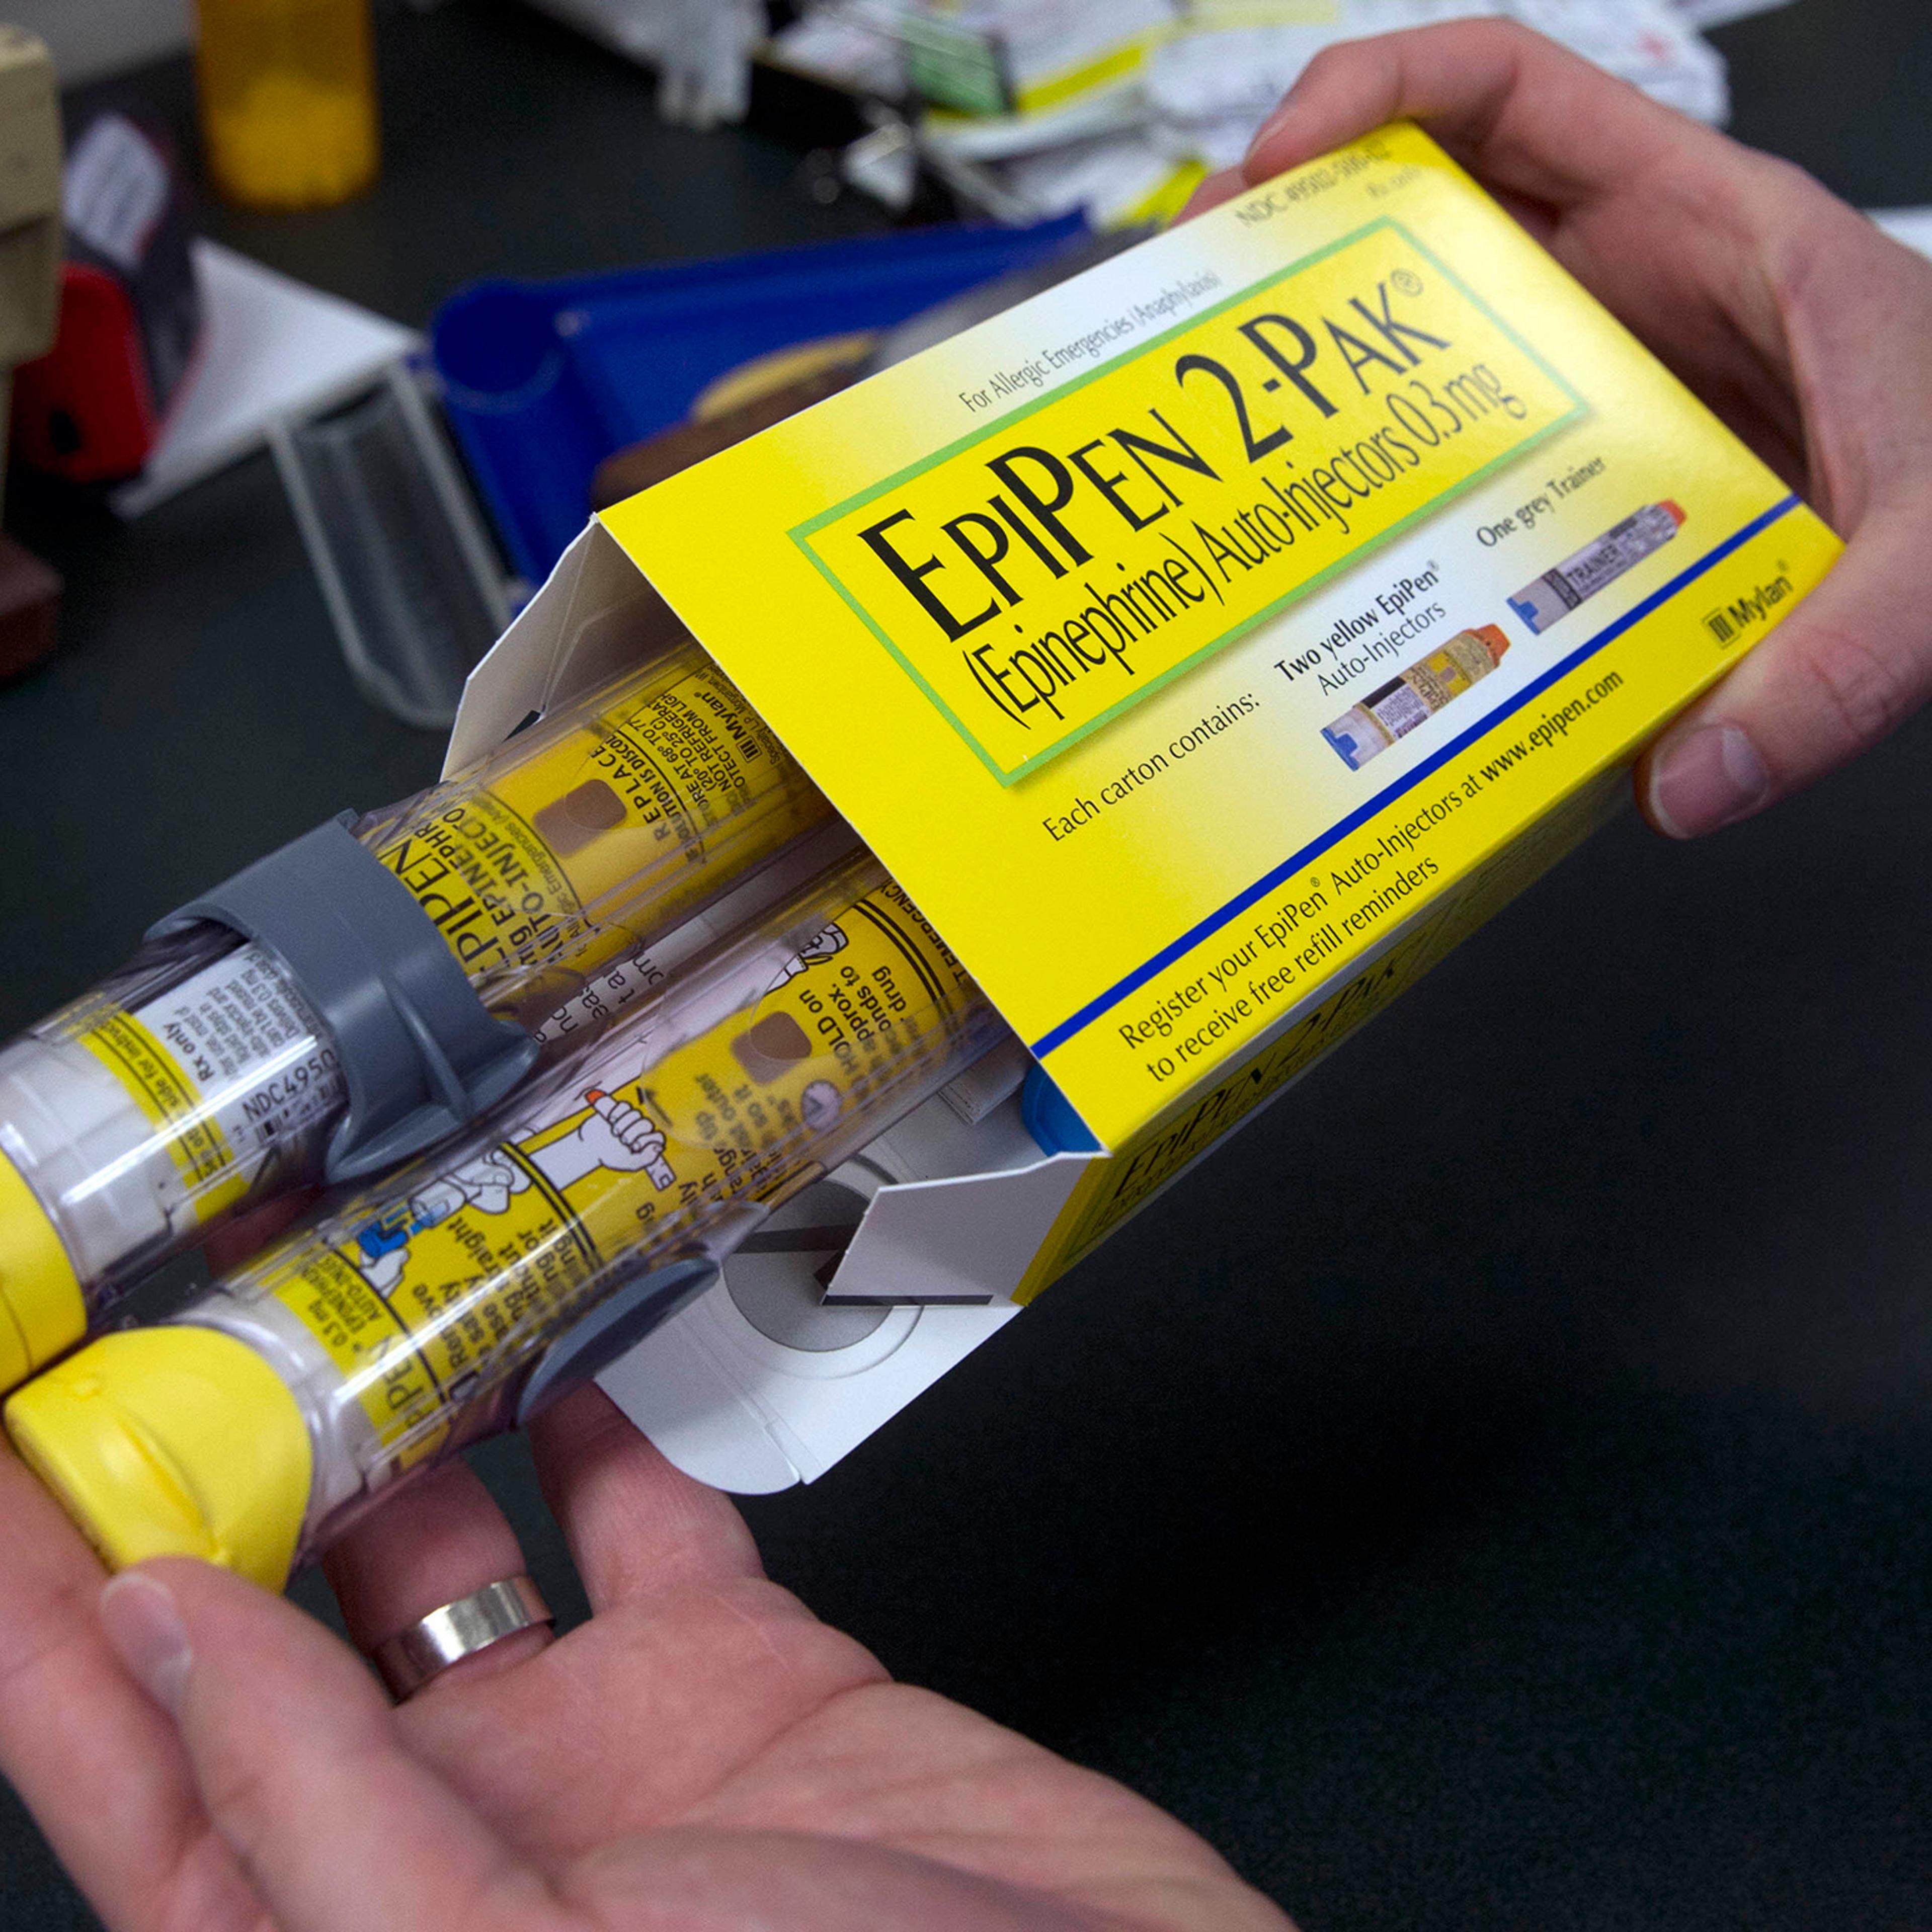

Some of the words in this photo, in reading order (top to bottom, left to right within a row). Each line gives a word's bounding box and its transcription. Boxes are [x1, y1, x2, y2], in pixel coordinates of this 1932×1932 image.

[958, 388, 992, 413] For
[989, 359, 1051, 400] Allergic
[1041, 315, 1135, 371] Emergencies
[1476, 517, 1517, 547] One
[1515, 496, 1552, 529] grey
[1546, 456, 1605, 499] Trainer
[961, 530, 1226, 733] (Epinephrine)
[1190, 423, 1422, 586] Auto-Injectors
[1442, 361, 1527, 425] mg
[1273, 648, 1321, 682] Two
[1319, 608, 1380, 661] yellow
[1317, 601, 1446, 697] Auto-Injectors
[642, 725, 662, 746] TO
[651, 714, 667, 731] C)
[683, 709, 718, 744] FROM
[640, 768, 656, 783] IS
[673, 764, 693, 780] AT
[679, 747, 698, 767] TO
[1042, 797, 1100, 842] Each
[1100, 754, 1169, 805] carton
[1168, 692, 1260, 759] contains:
[590, 745, 670, 840] REPLACE
[707, 763, 732, 792] NOT
[648, 780, 694, 844] OLUTION
[1118, 977, 1210, 1051] Register
[1207, 940, 1259, 992] your
[1329, 790, 1464, 897] Auto-Injectors
[1460, 774, 1483, 798] at
[1479, 671, 1624, 783] www.epipen.com
[840, 965, 860, 987] to
[871, 965, 907, 1012] drug
[1146, 1057, 1175, 1082] to
[1174, 998, 1253, 1063] receive
[1248, 965, 1296, 1005] free
[1294, 923, 1343, 973] refill
[1340, 856, 1439, 937] reminders
[798, 989, 823, 1013] on
[161, 1019, 197, 1058] only
[814, 1013, 862, 1073] HOLD
[190, 1055, 215, 1083] Rx
[515, 1228, 540, 1253] or
[536, 1218, 558, 1239] it
